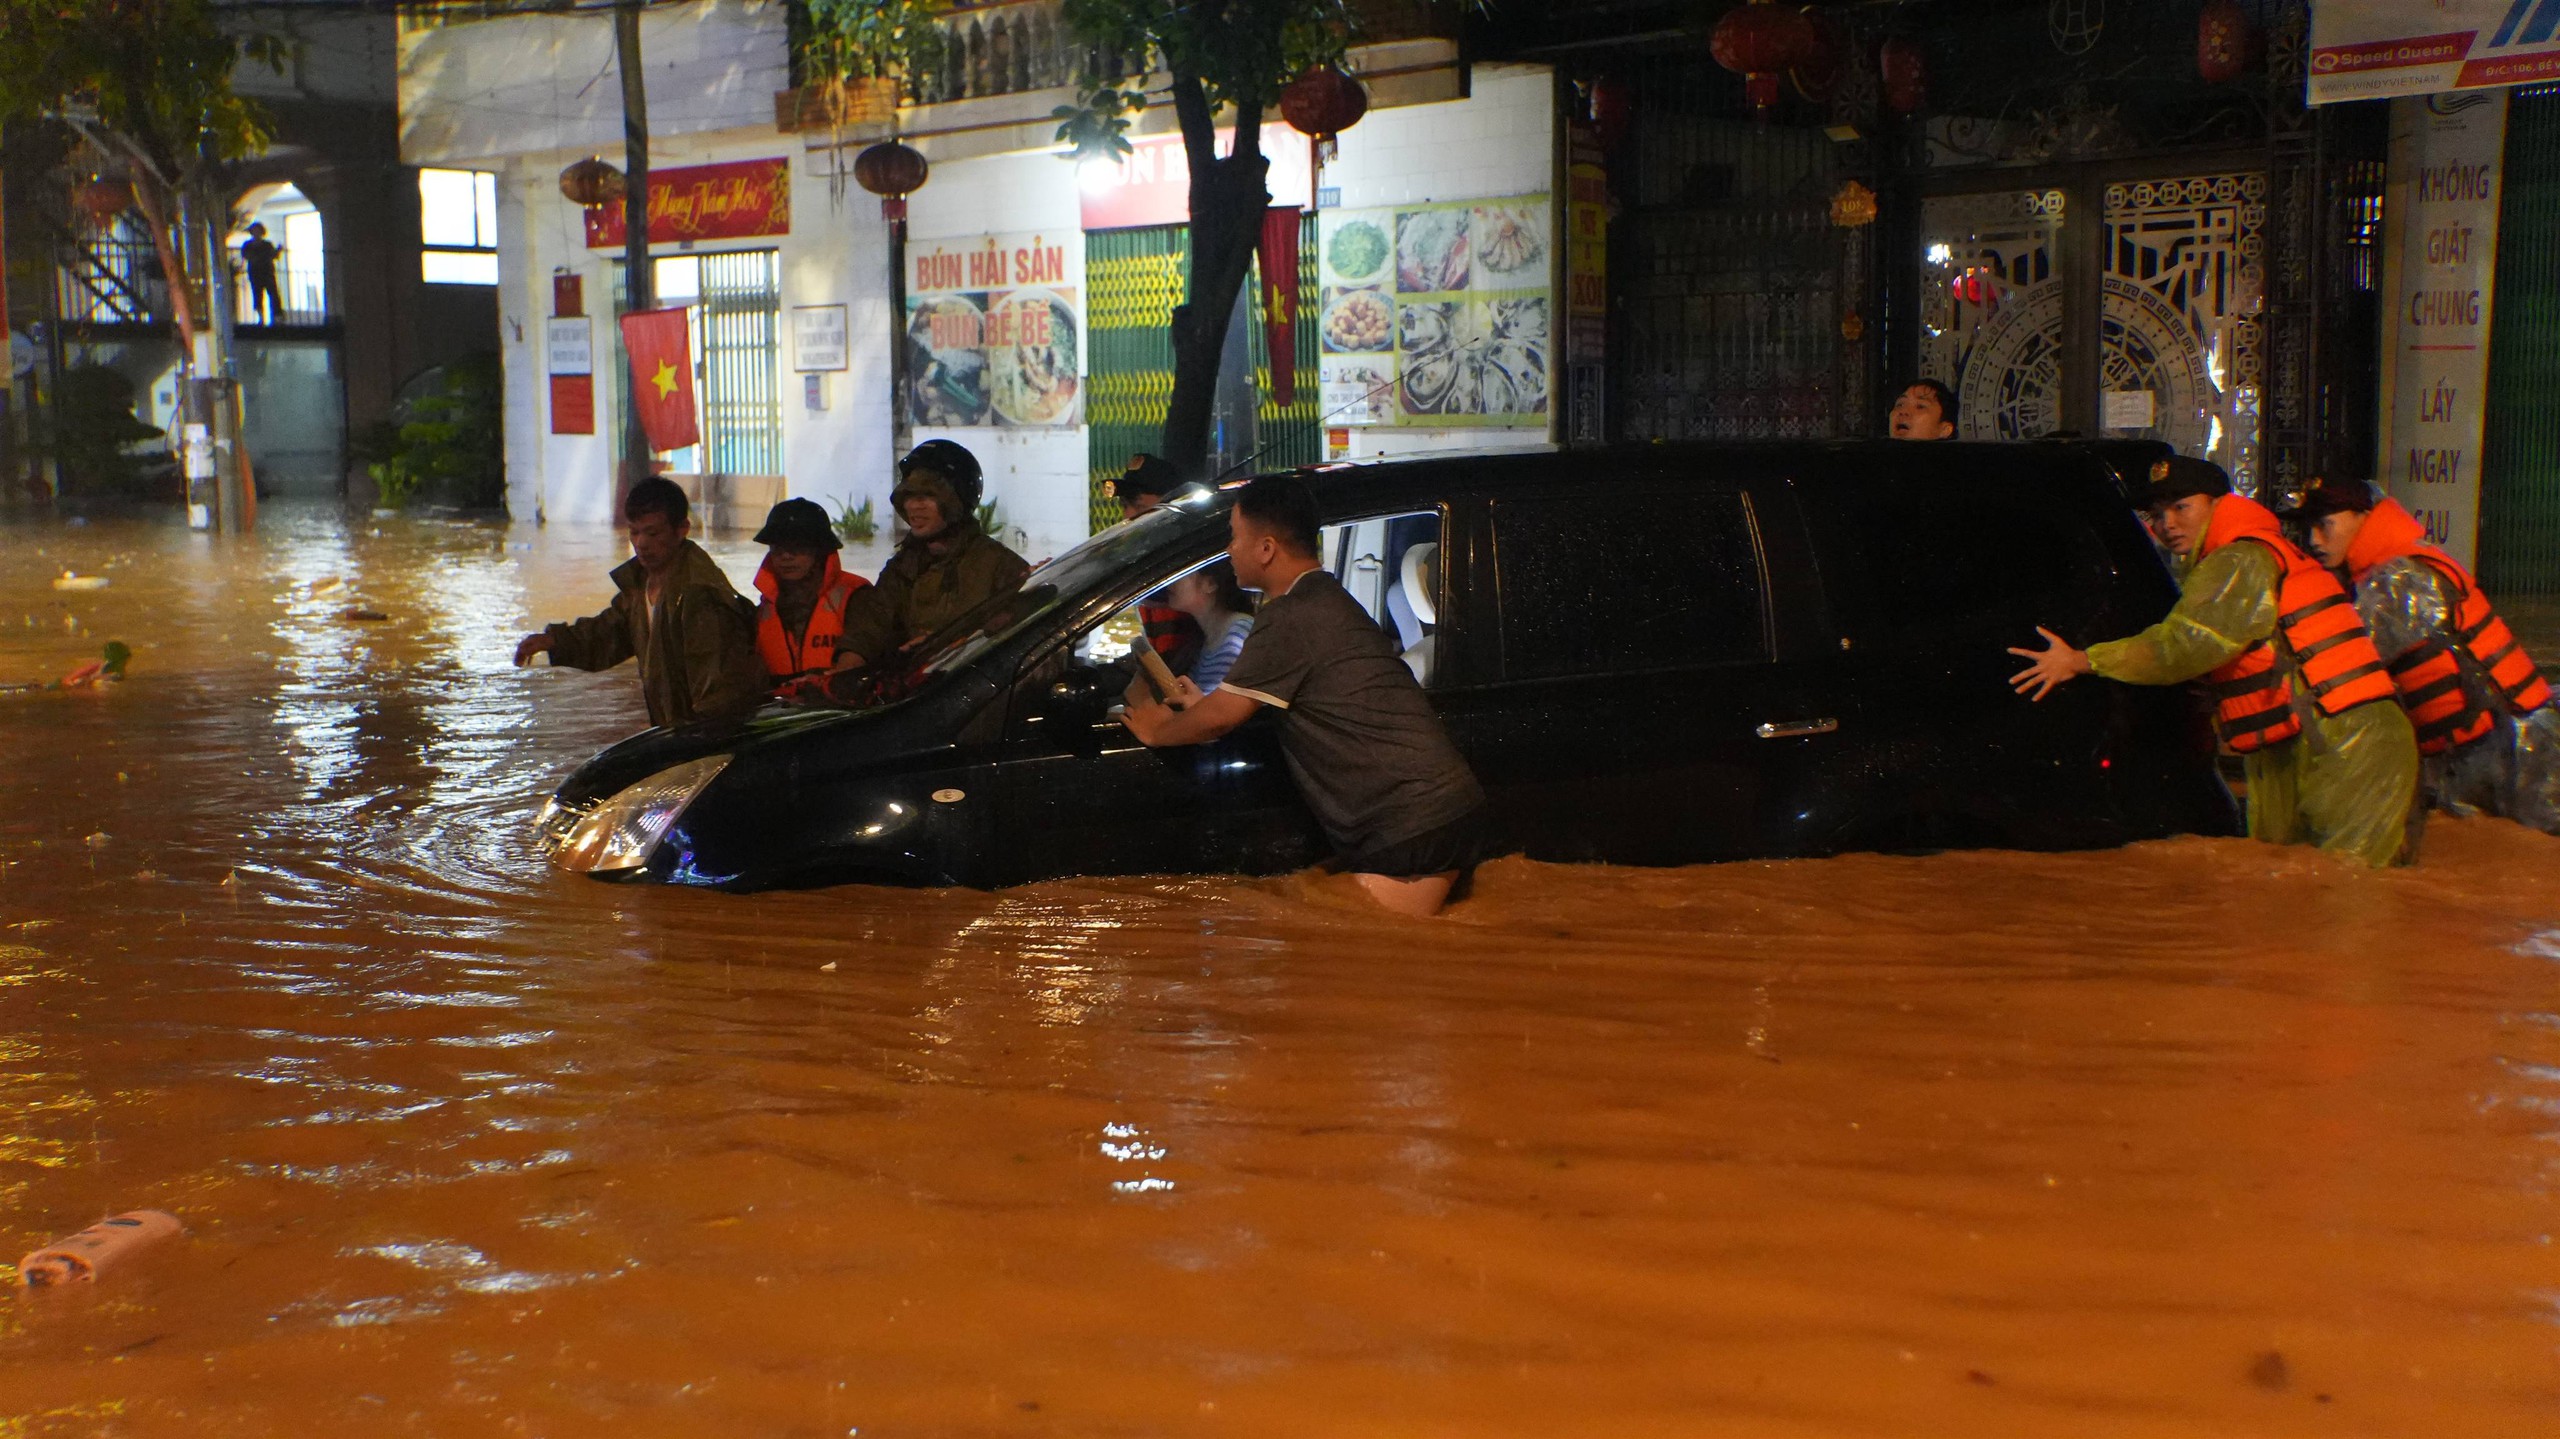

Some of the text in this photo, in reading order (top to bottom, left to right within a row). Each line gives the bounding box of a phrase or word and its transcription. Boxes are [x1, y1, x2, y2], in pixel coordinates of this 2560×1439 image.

[2341, 49, 2393, 66] Speed
[2398, 45, 2454, 60] Queen
[2418, 158, 2490, 203] KHÔNG
[917, 234, 1064, 291] BÚN HẢI SẢN
[2427, 220, 2472, 274] GIẶT
[2411, 290, 2480, 326] CHUNG
[2421, 375, 2457, 423] LẤY
[2409, 448, 2461, 484] NGAY
